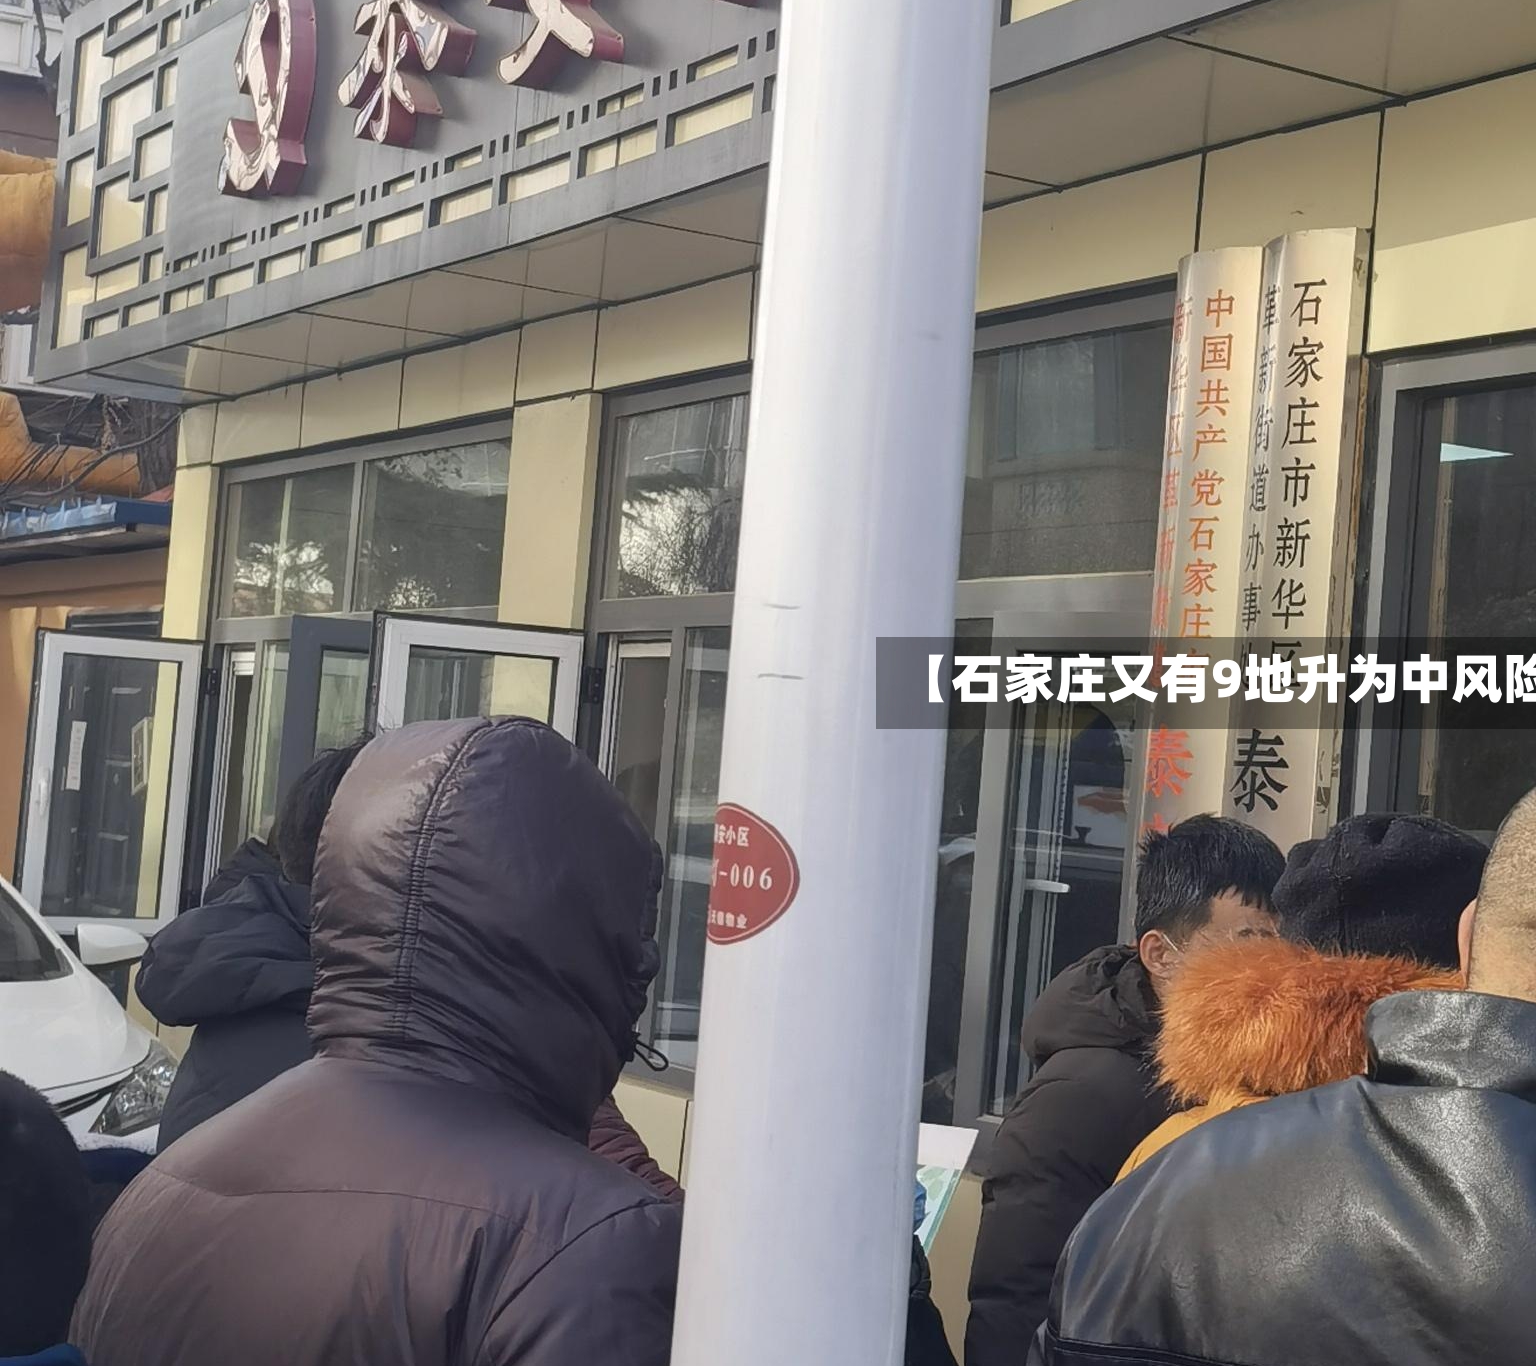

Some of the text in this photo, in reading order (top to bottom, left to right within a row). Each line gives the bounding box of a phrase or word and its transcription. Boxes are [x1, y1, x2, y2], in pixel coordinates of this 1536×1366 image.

[1179, 288, 1236, 691] 中国共产党石家庄
[1229, 727, 1290, 814] 泰
